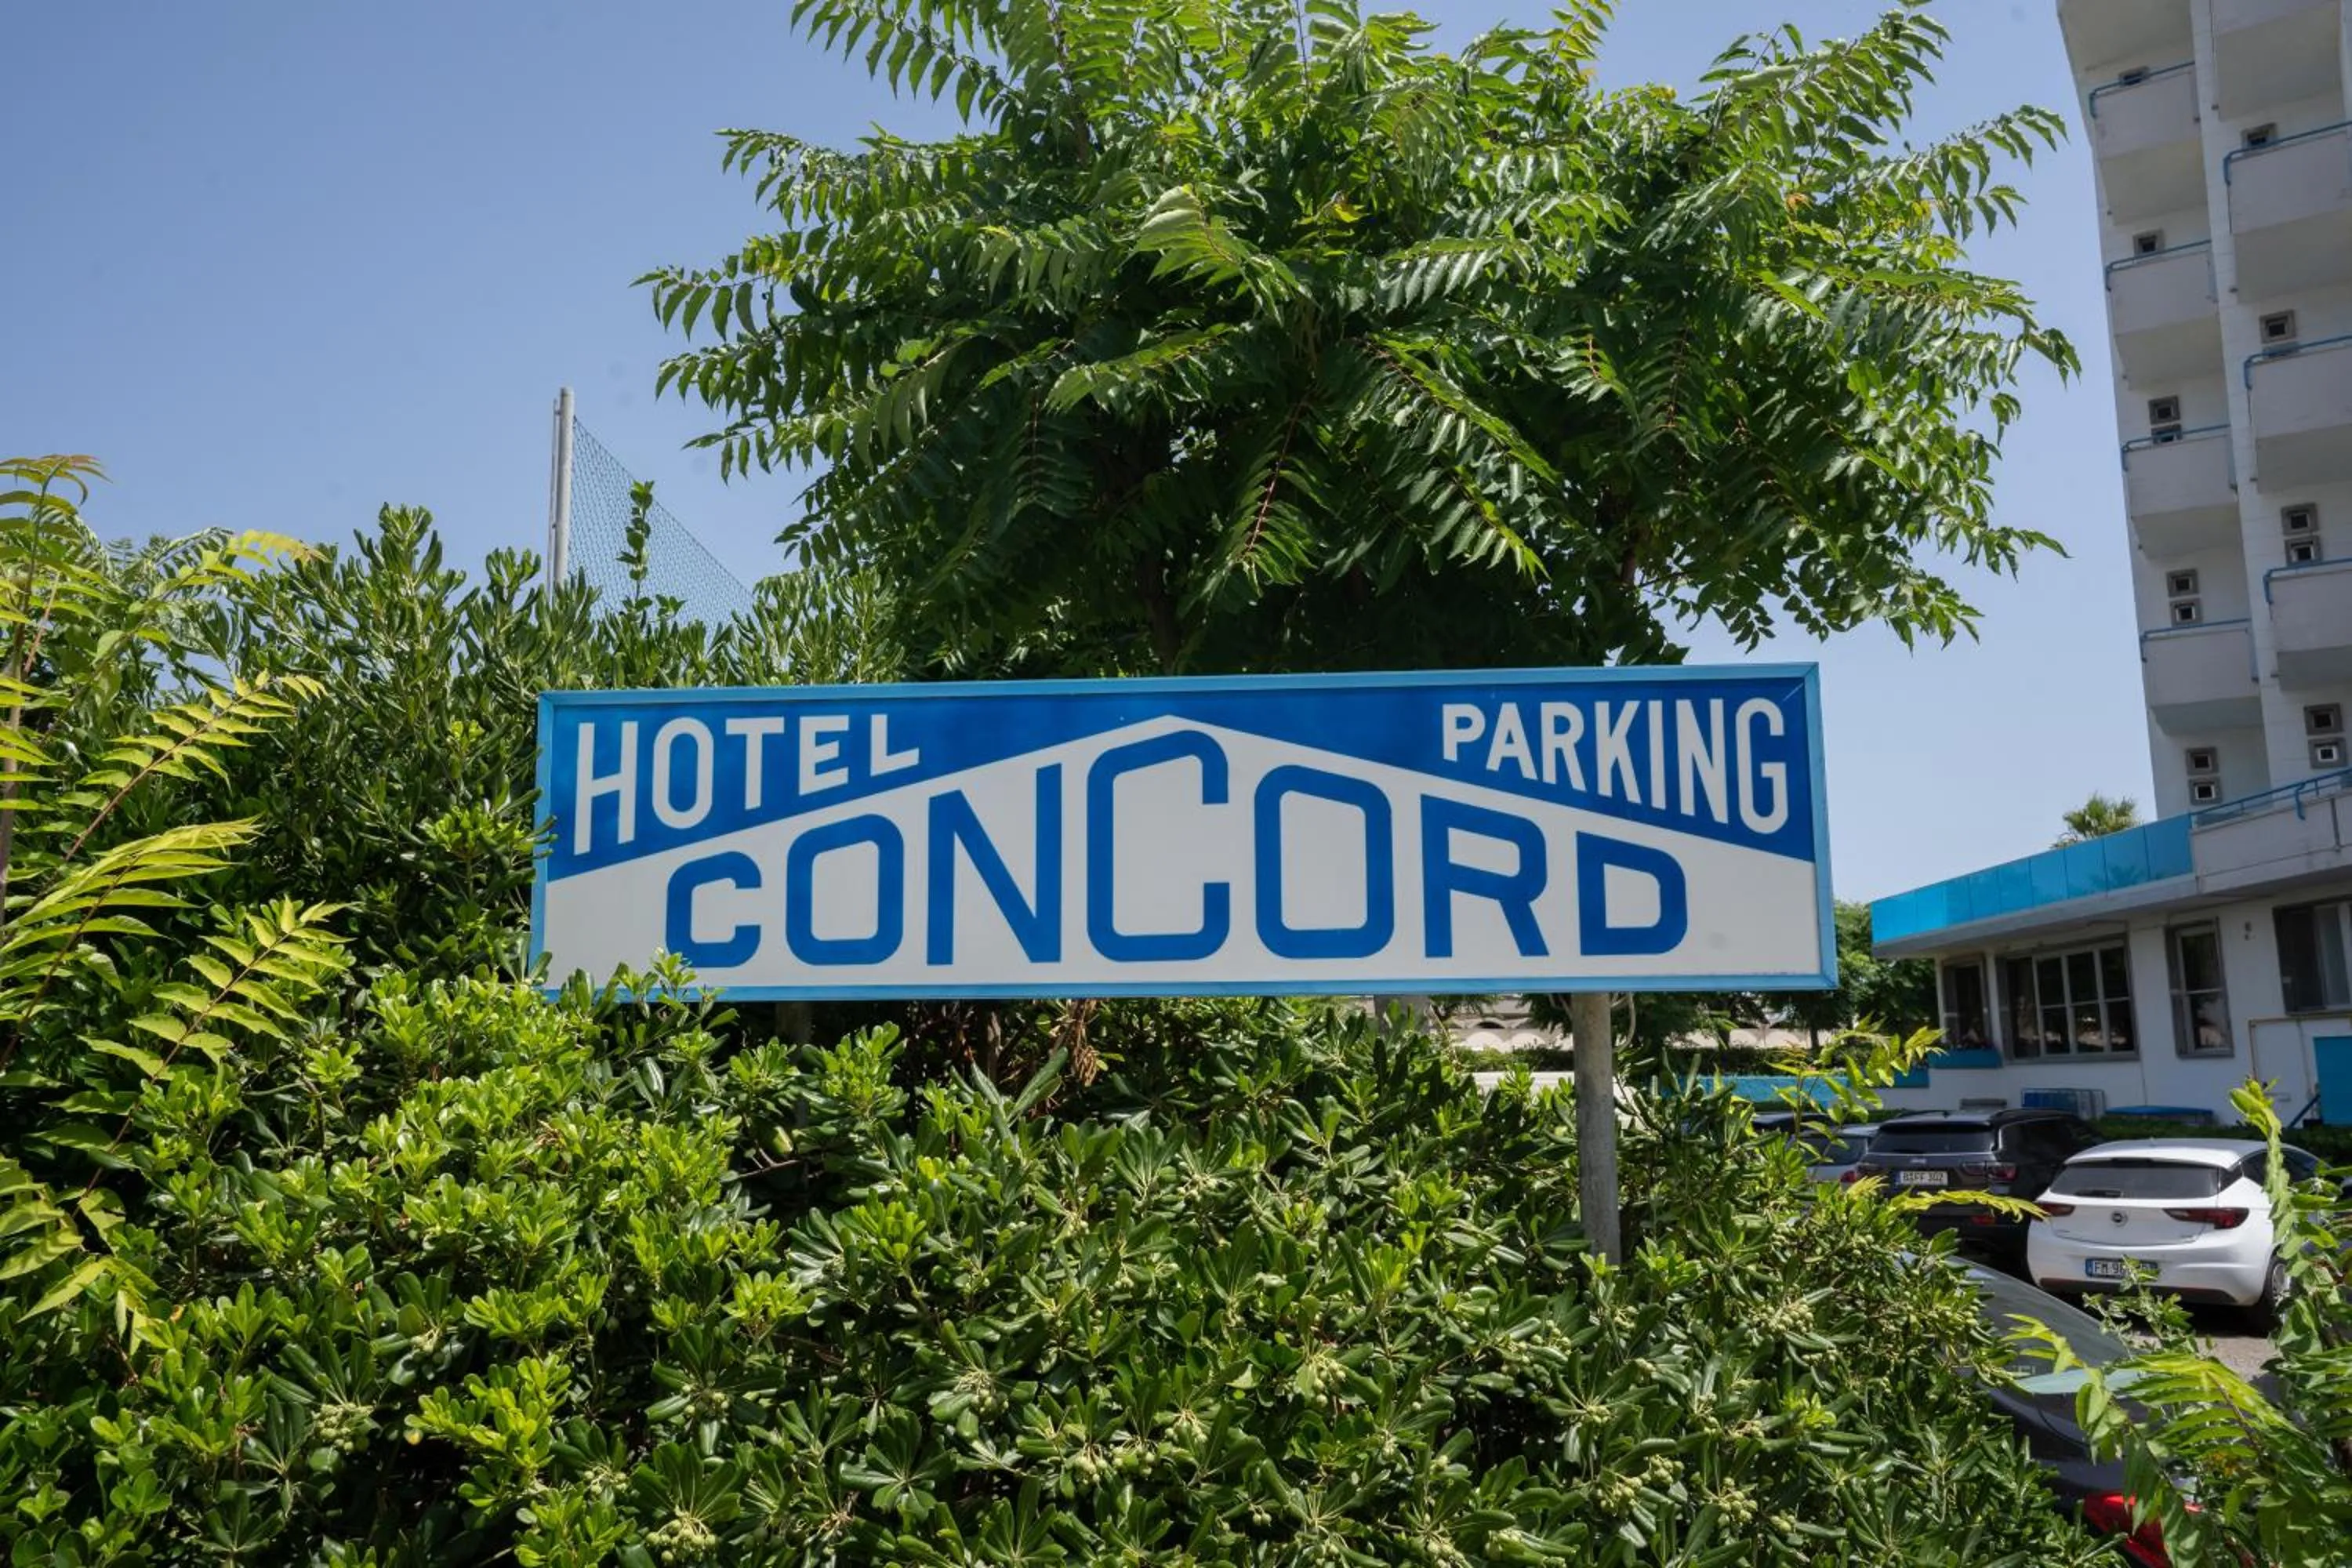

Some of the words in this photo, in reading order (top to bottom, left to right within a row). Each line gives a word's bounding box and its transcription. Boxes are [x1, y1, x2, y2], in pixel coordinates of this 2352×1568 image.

[574, 714, 919, 855] HOTEL
[1443, 697, 1788, 834] PARKING
[666, 729, 1688, 967] CONCORD
